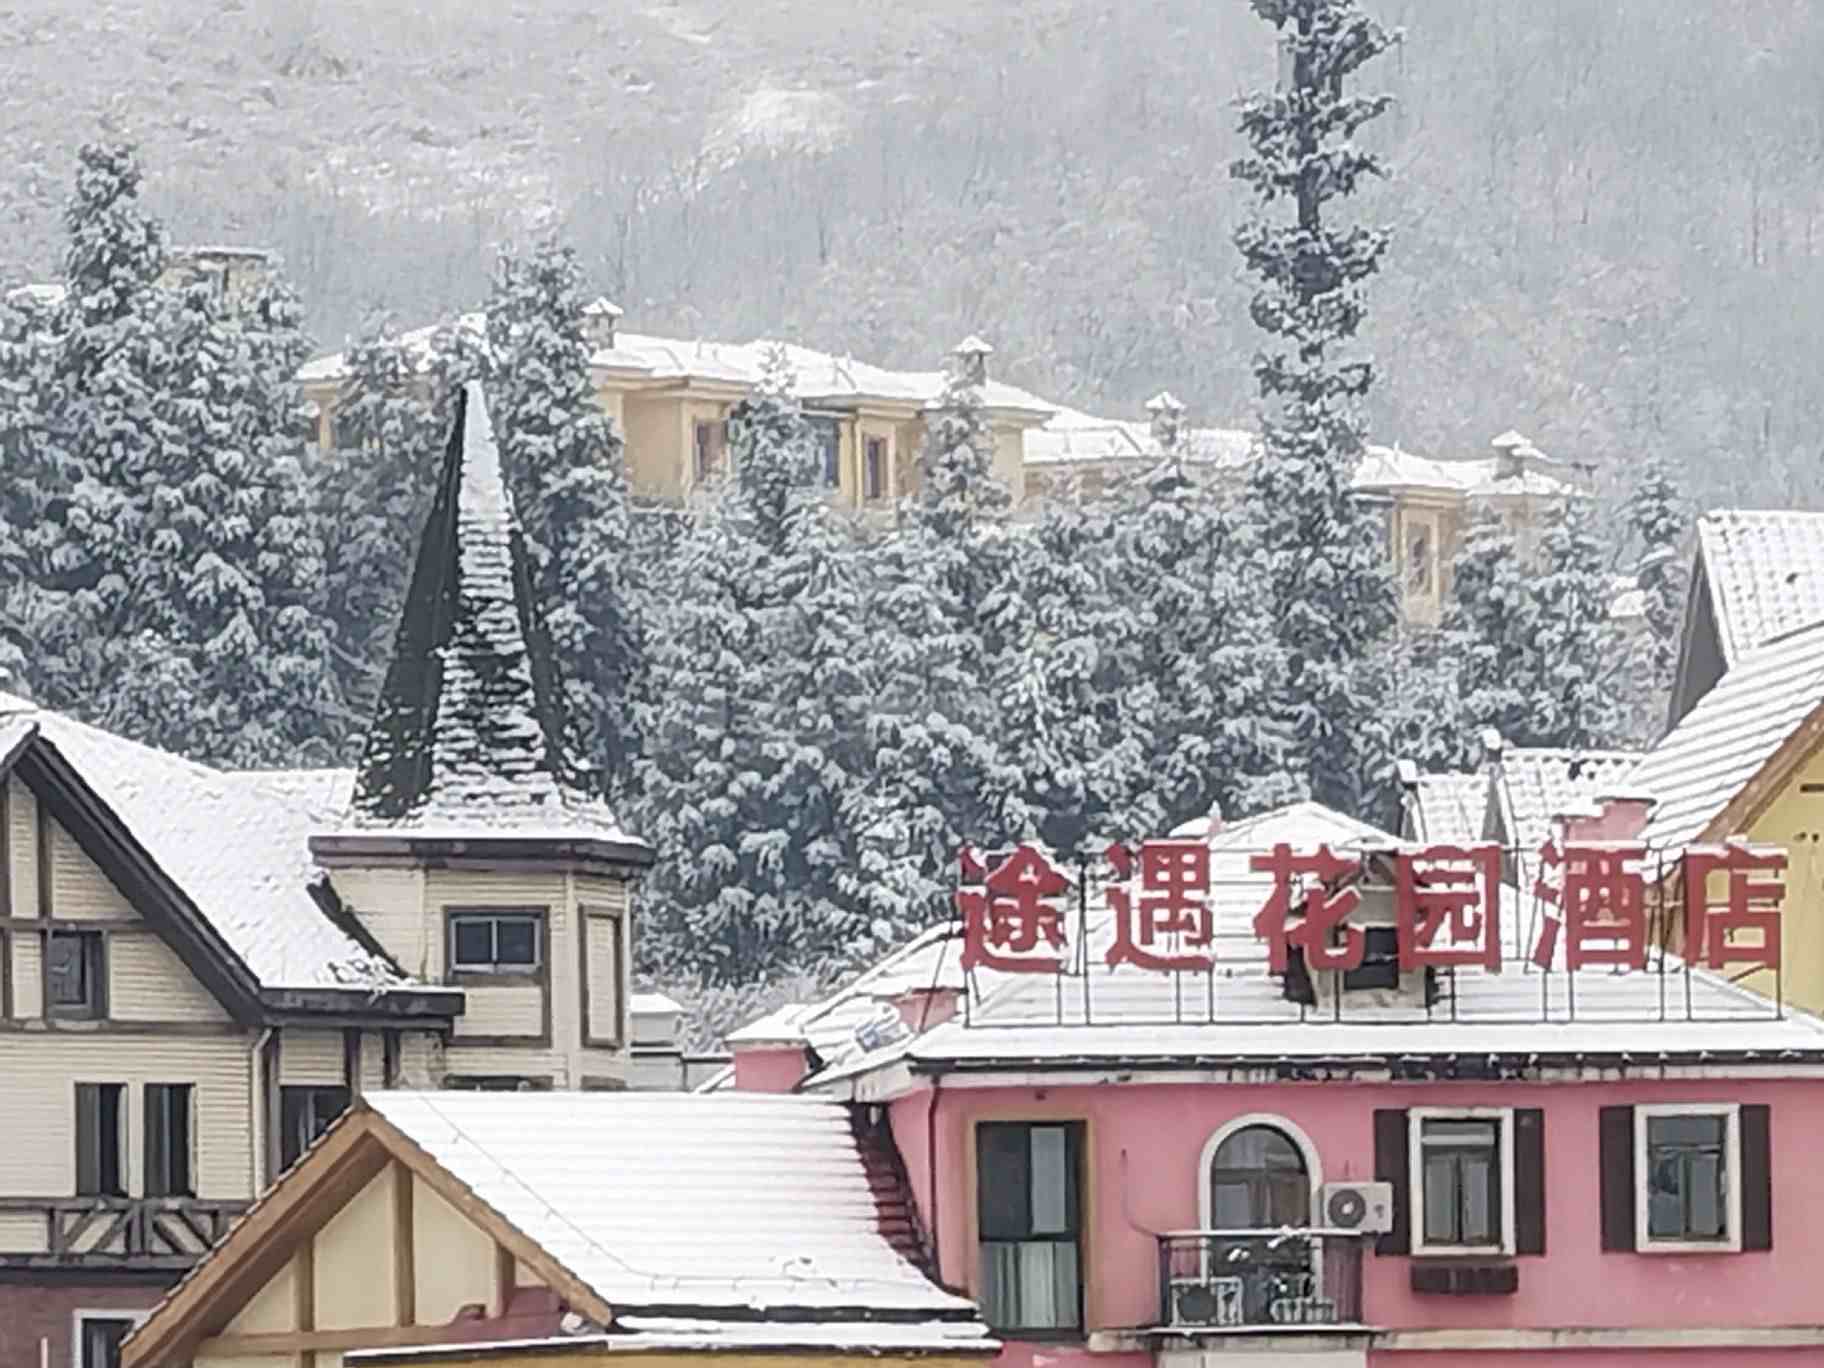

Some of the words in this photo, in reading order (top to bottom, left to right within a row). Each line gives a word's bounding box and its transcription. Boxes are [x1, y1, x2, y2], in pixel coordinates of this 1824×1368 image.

[958, 843, 1788, 974] 途遇花园酒店
